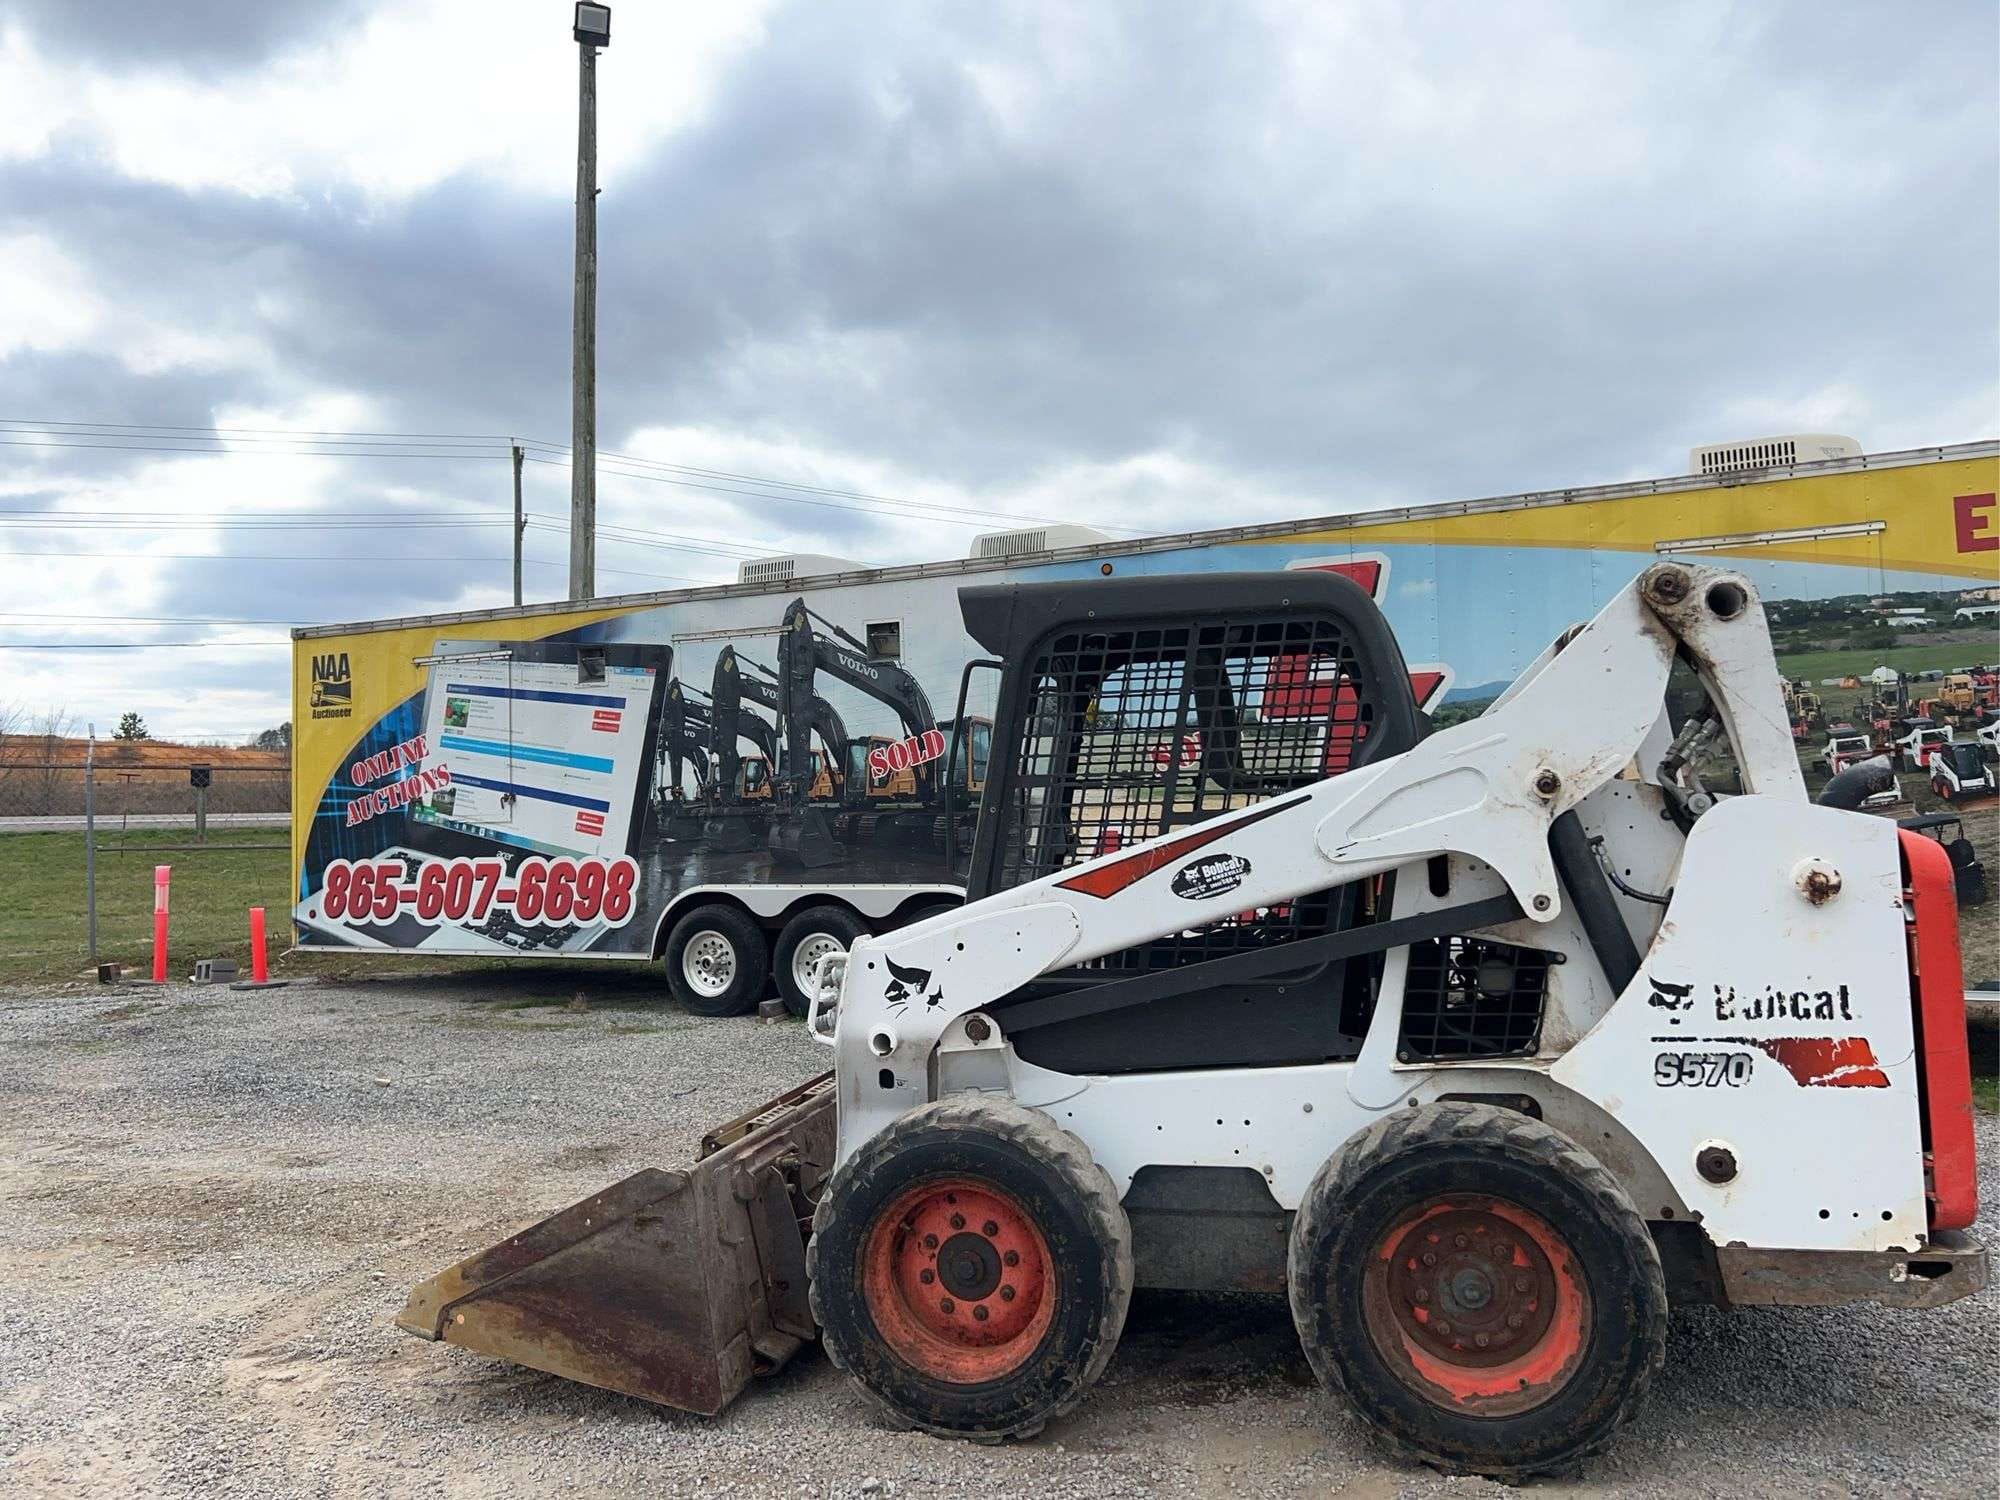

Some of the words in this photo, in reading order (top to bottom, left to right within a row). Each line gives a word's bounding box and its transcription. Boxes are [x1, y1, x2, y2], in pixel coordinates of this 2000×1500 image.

[312, 653, 351, 682] NAA
[838, 653, 879, 680] VOLVO
[312, 708, 352, 719] Auctioneer
[351, 733, 430, 787] ONLINE
[868, 729, 946, 779] SOLD
[346, 763, 452, 827] AUCTIONS
[496, 850, 514, 861] acer
[1201, 857, 1242, 878] Bobcat
[322, 859, 637, 923] 865-607-6698
[1655, 1052, 1754, 1088] S570
